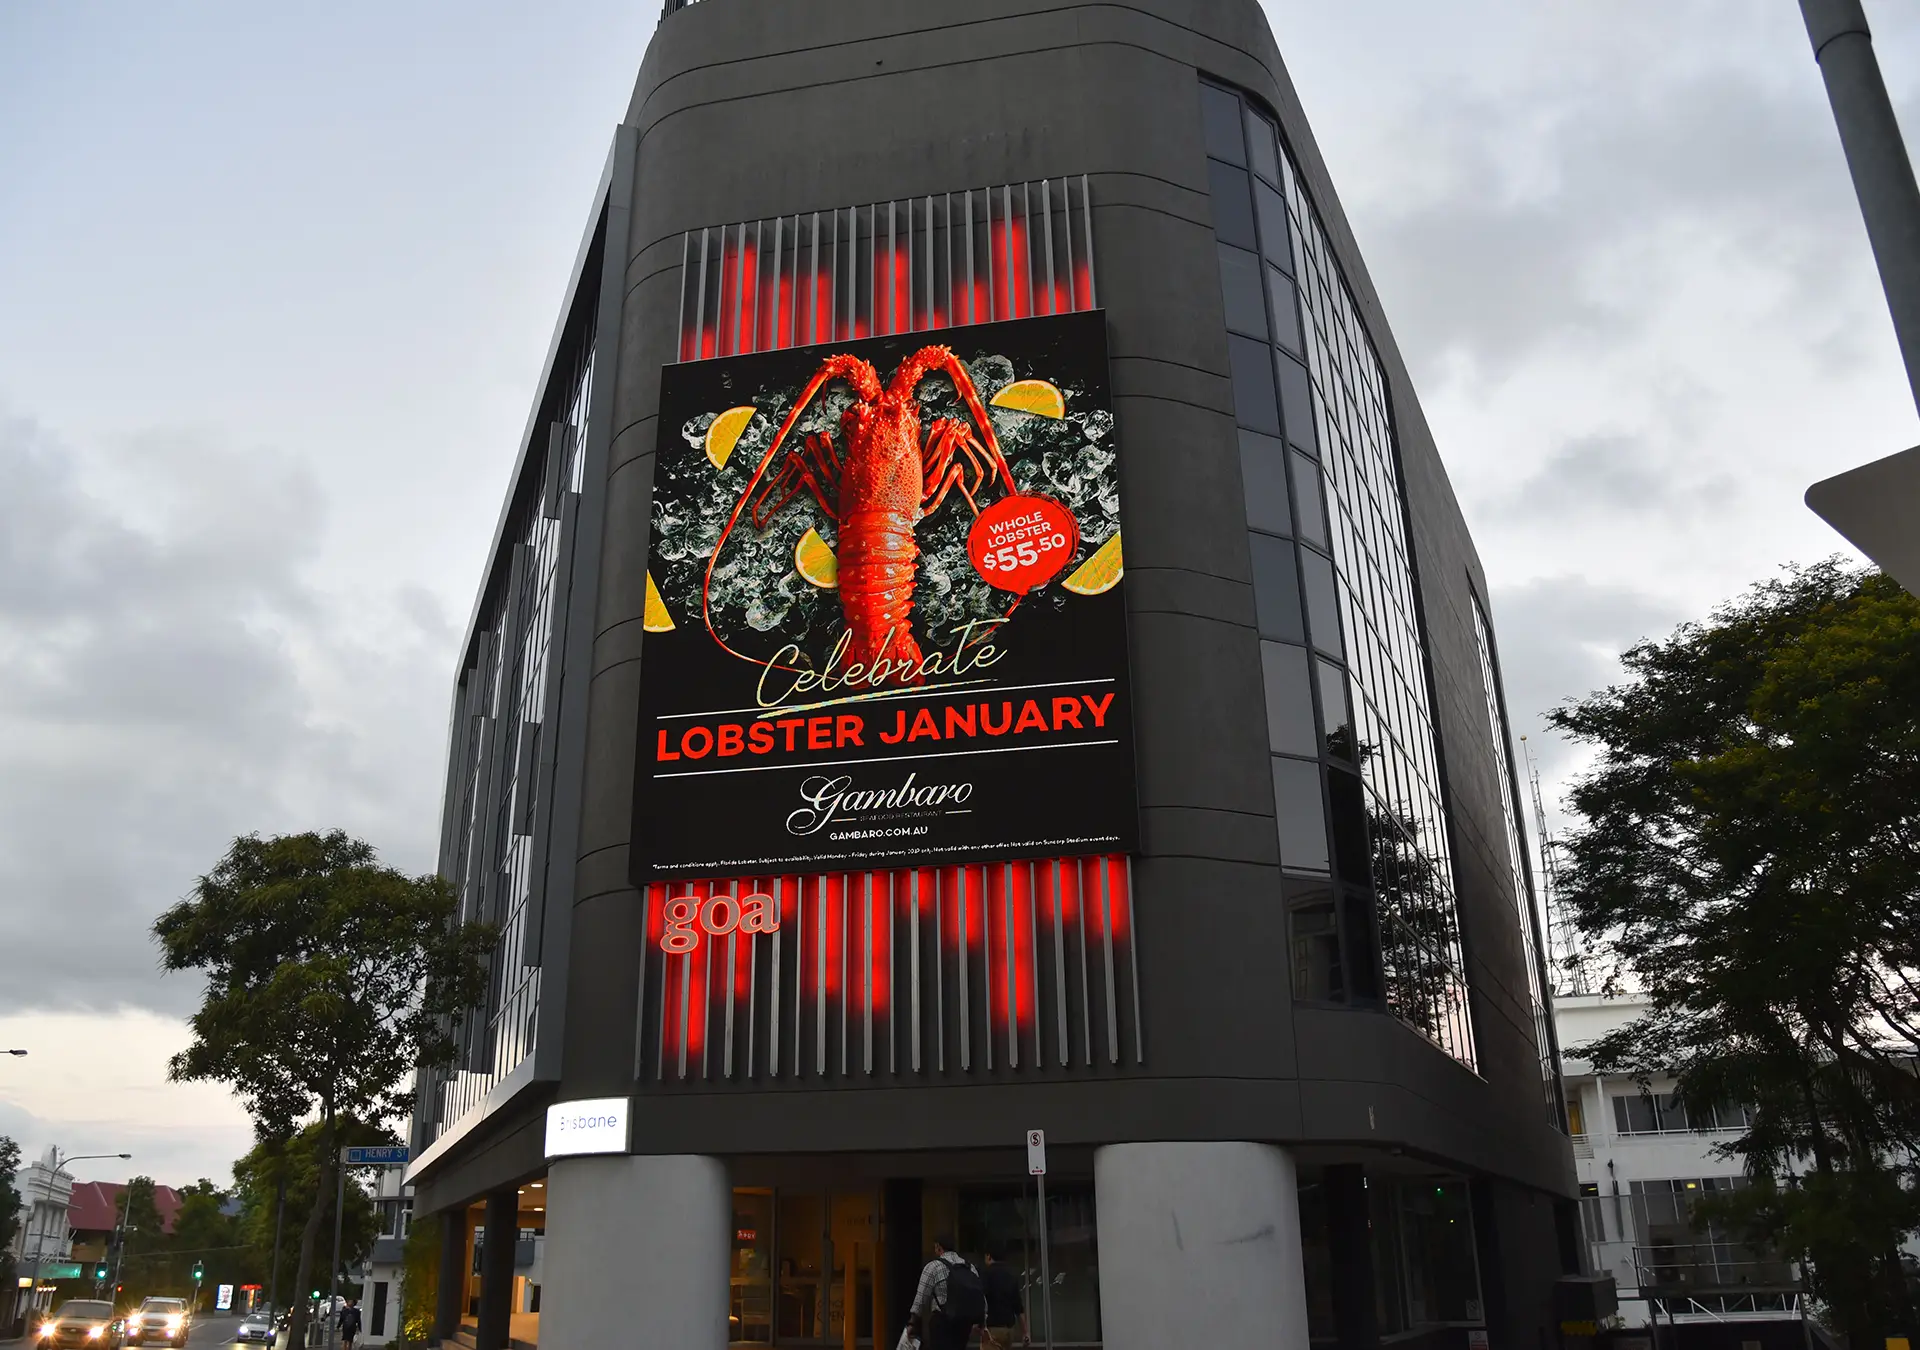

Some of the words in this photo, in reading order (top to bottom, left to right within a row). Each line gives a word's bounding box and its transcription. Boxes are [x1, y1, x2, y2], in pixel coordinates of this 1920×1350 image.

[988, 521, 1052, 548] LOBSTER
[989, 511, 1043, 535] WHOLE
[983, 533, 1066, 572] $55.50
[756, 617, 1010, 707] Celebrate
[656, 714, 865, 762] LOBSTER
[879, 692, 1115, 744] JANUARY
[785, 772, 973, 836] Gambaro
[829, 826, 929, 841] GAMBARO.COM.AU
[660, 893, 780, 953] goa
[365, 1148, 392, 1158] HENRY
[396, 1148, 406, 1158] ST
